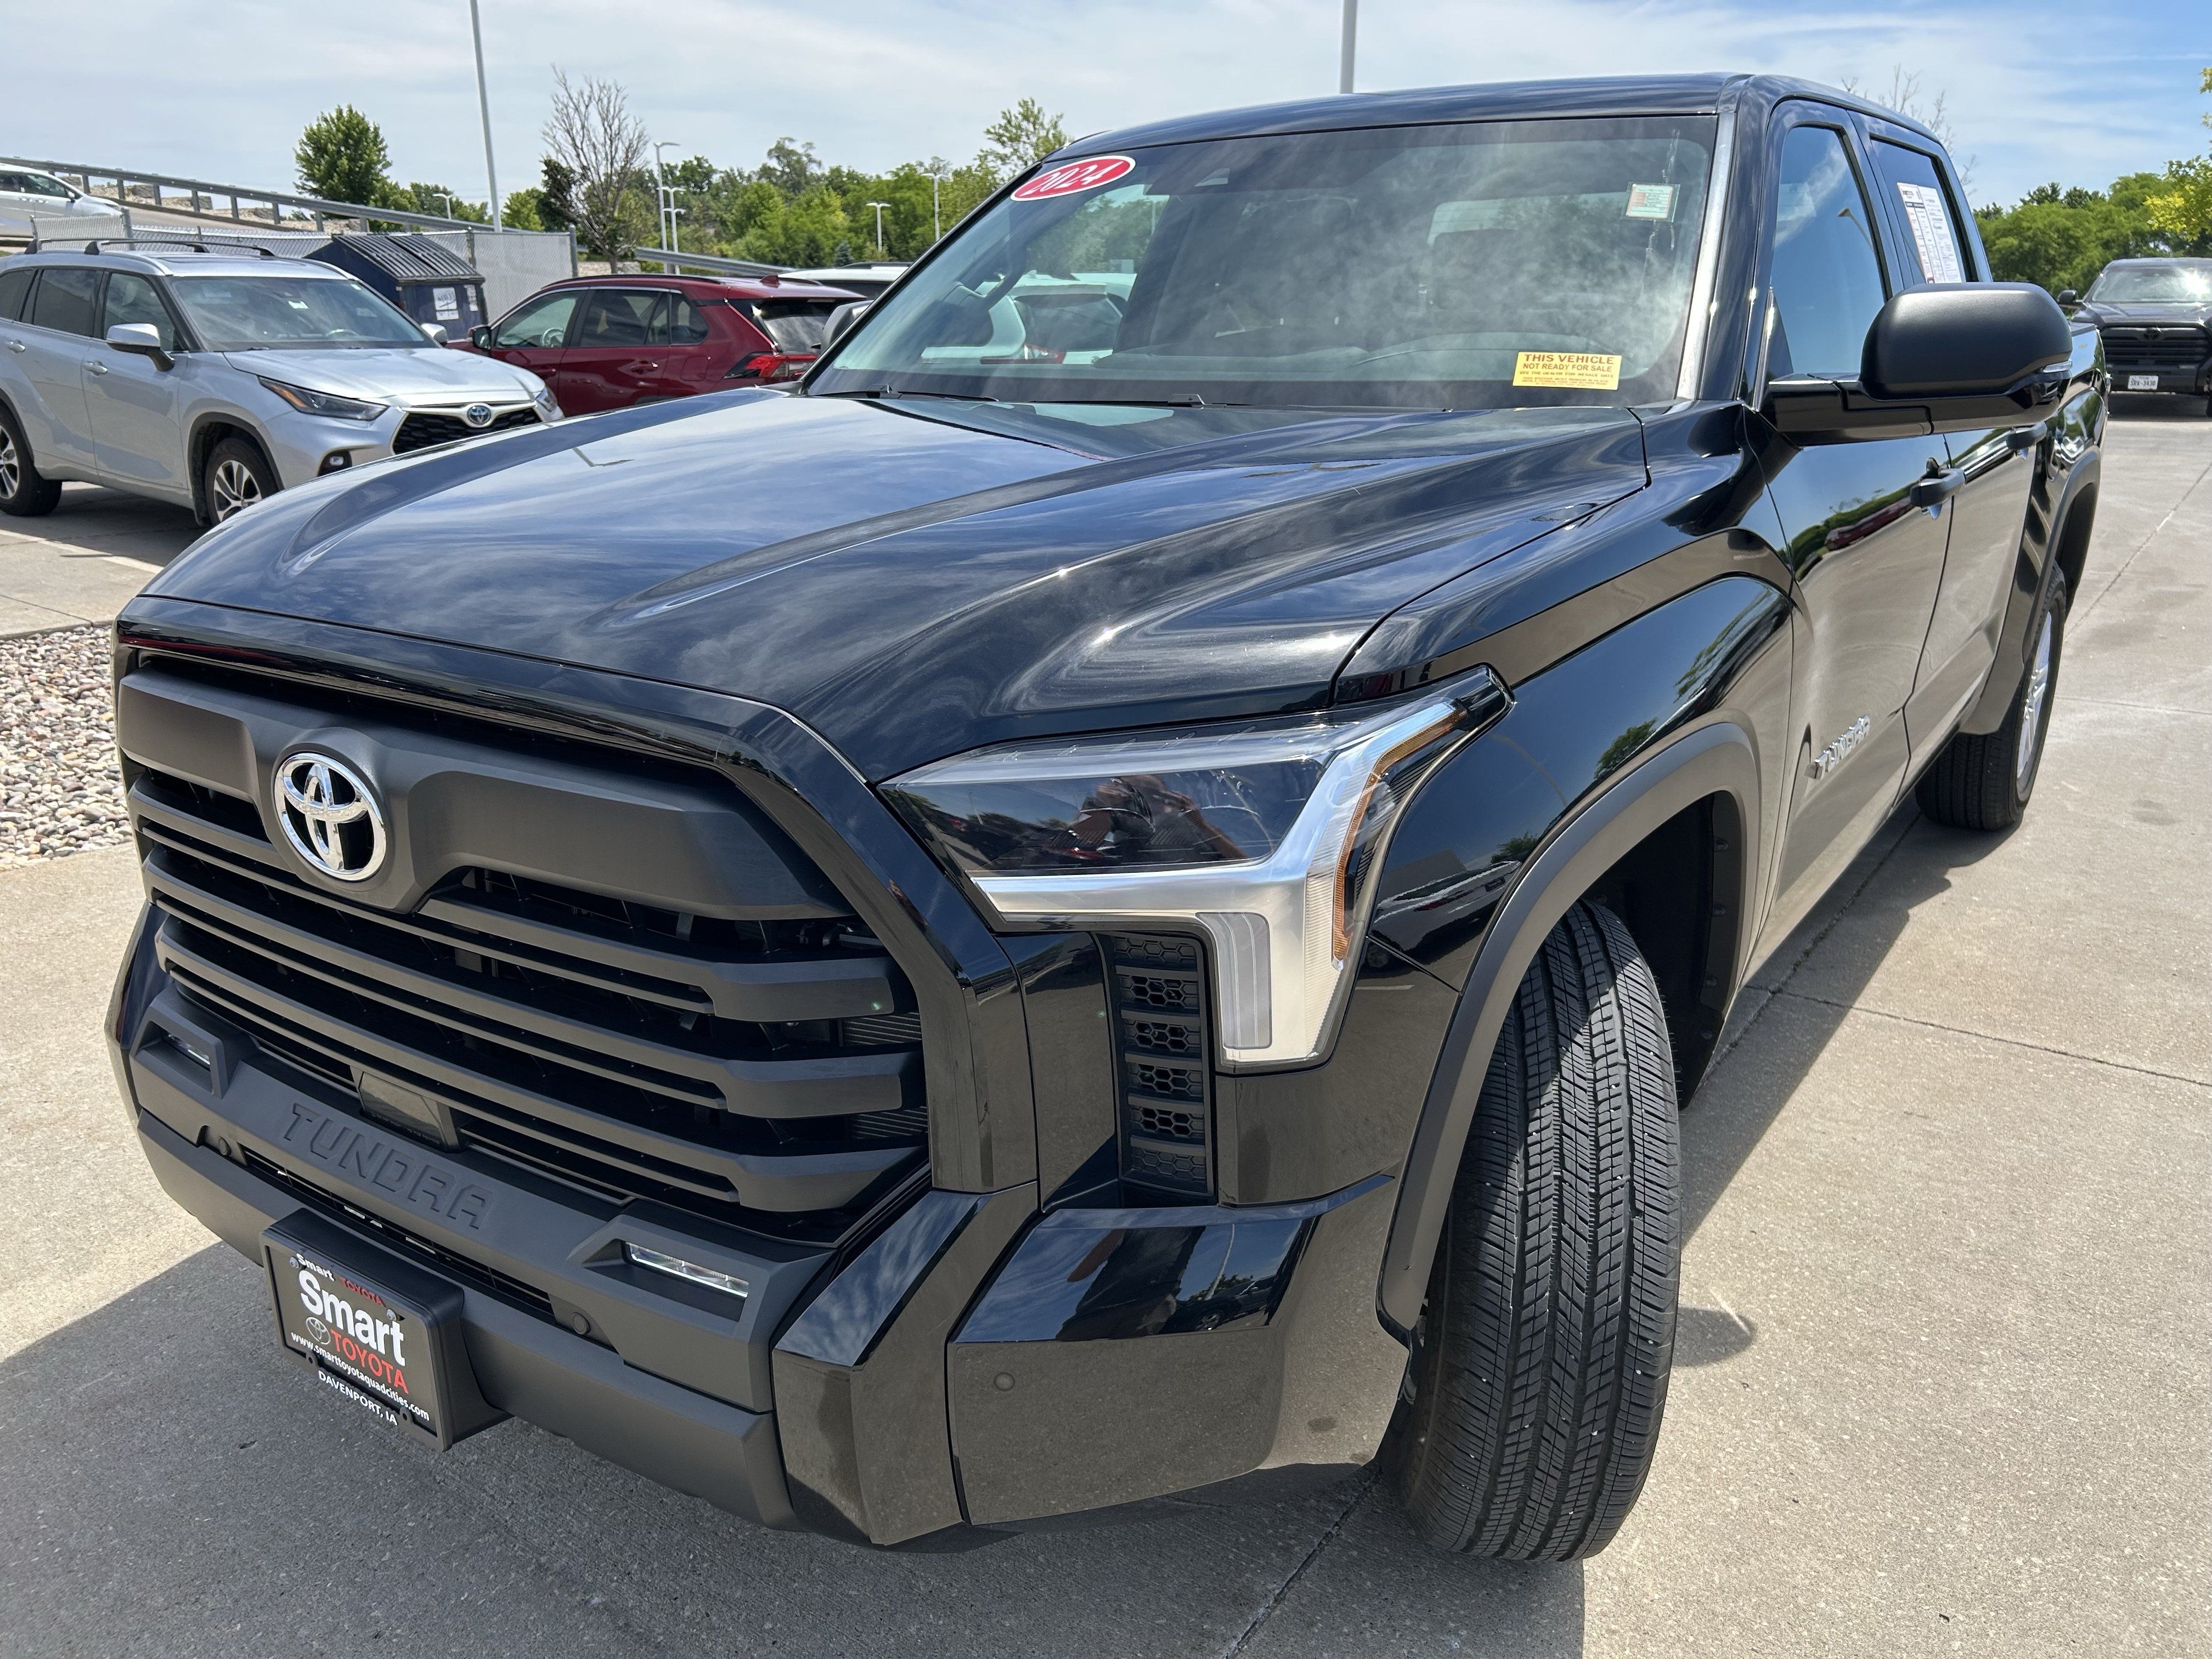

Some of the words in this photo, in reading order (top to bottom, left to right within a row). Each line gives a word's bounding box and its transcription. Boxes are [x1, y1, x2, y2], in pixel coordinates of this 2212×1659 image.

[1019, 161, 1124, 197] 2024
[1525, 354, 1554, 362] THIS
[1558, 354, 1615, 365] VEHICLE
[1813, 714, 1870, 780] TUNDRA
[283, 1102, 495, 1230] TUNDRA
[296, 1253, 335, 1282] Smart
[339, 1277, 386, 1308] TOYOTA
[298, 1270, 405, 1367] Smart
[291, 1332, 430, 1421] www.smarttoyotaquadcities.com
[330, 1329, 409, 1394] TOYOTA
[318, 1370, 383, 1418] DAVENPORT,
[386, 1410, 398, 1426] IA
